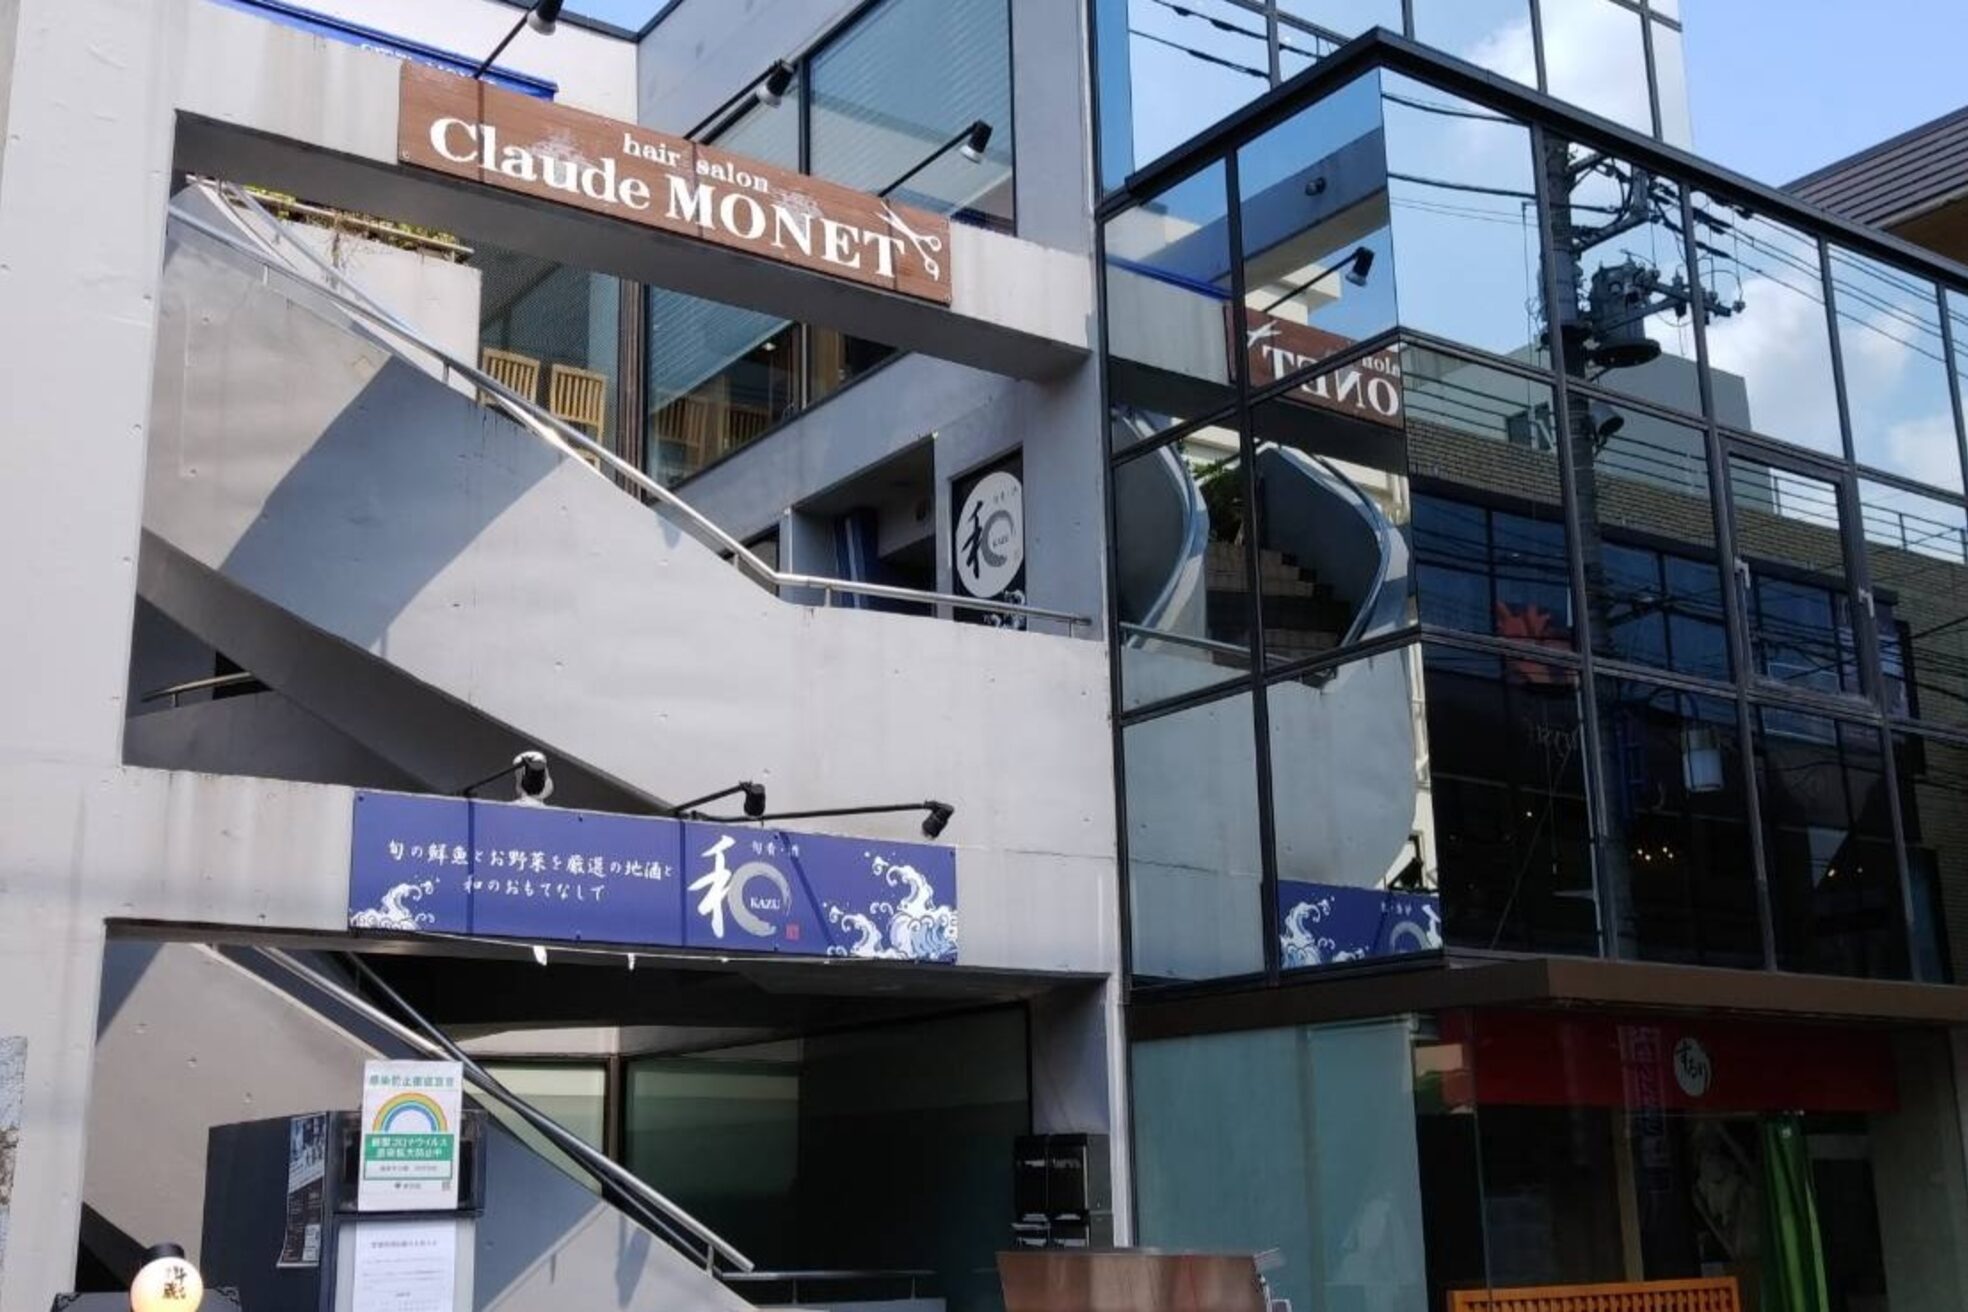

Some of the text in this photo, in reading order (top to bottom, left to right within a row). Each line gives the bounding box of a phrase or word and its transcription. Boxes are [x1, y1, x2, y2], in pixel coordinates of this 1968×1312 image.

[623, 132, 769, 194] hair salon
[429, 116, 905, 279] Claude MONET
[750, 896, 780, 910] KAZU
